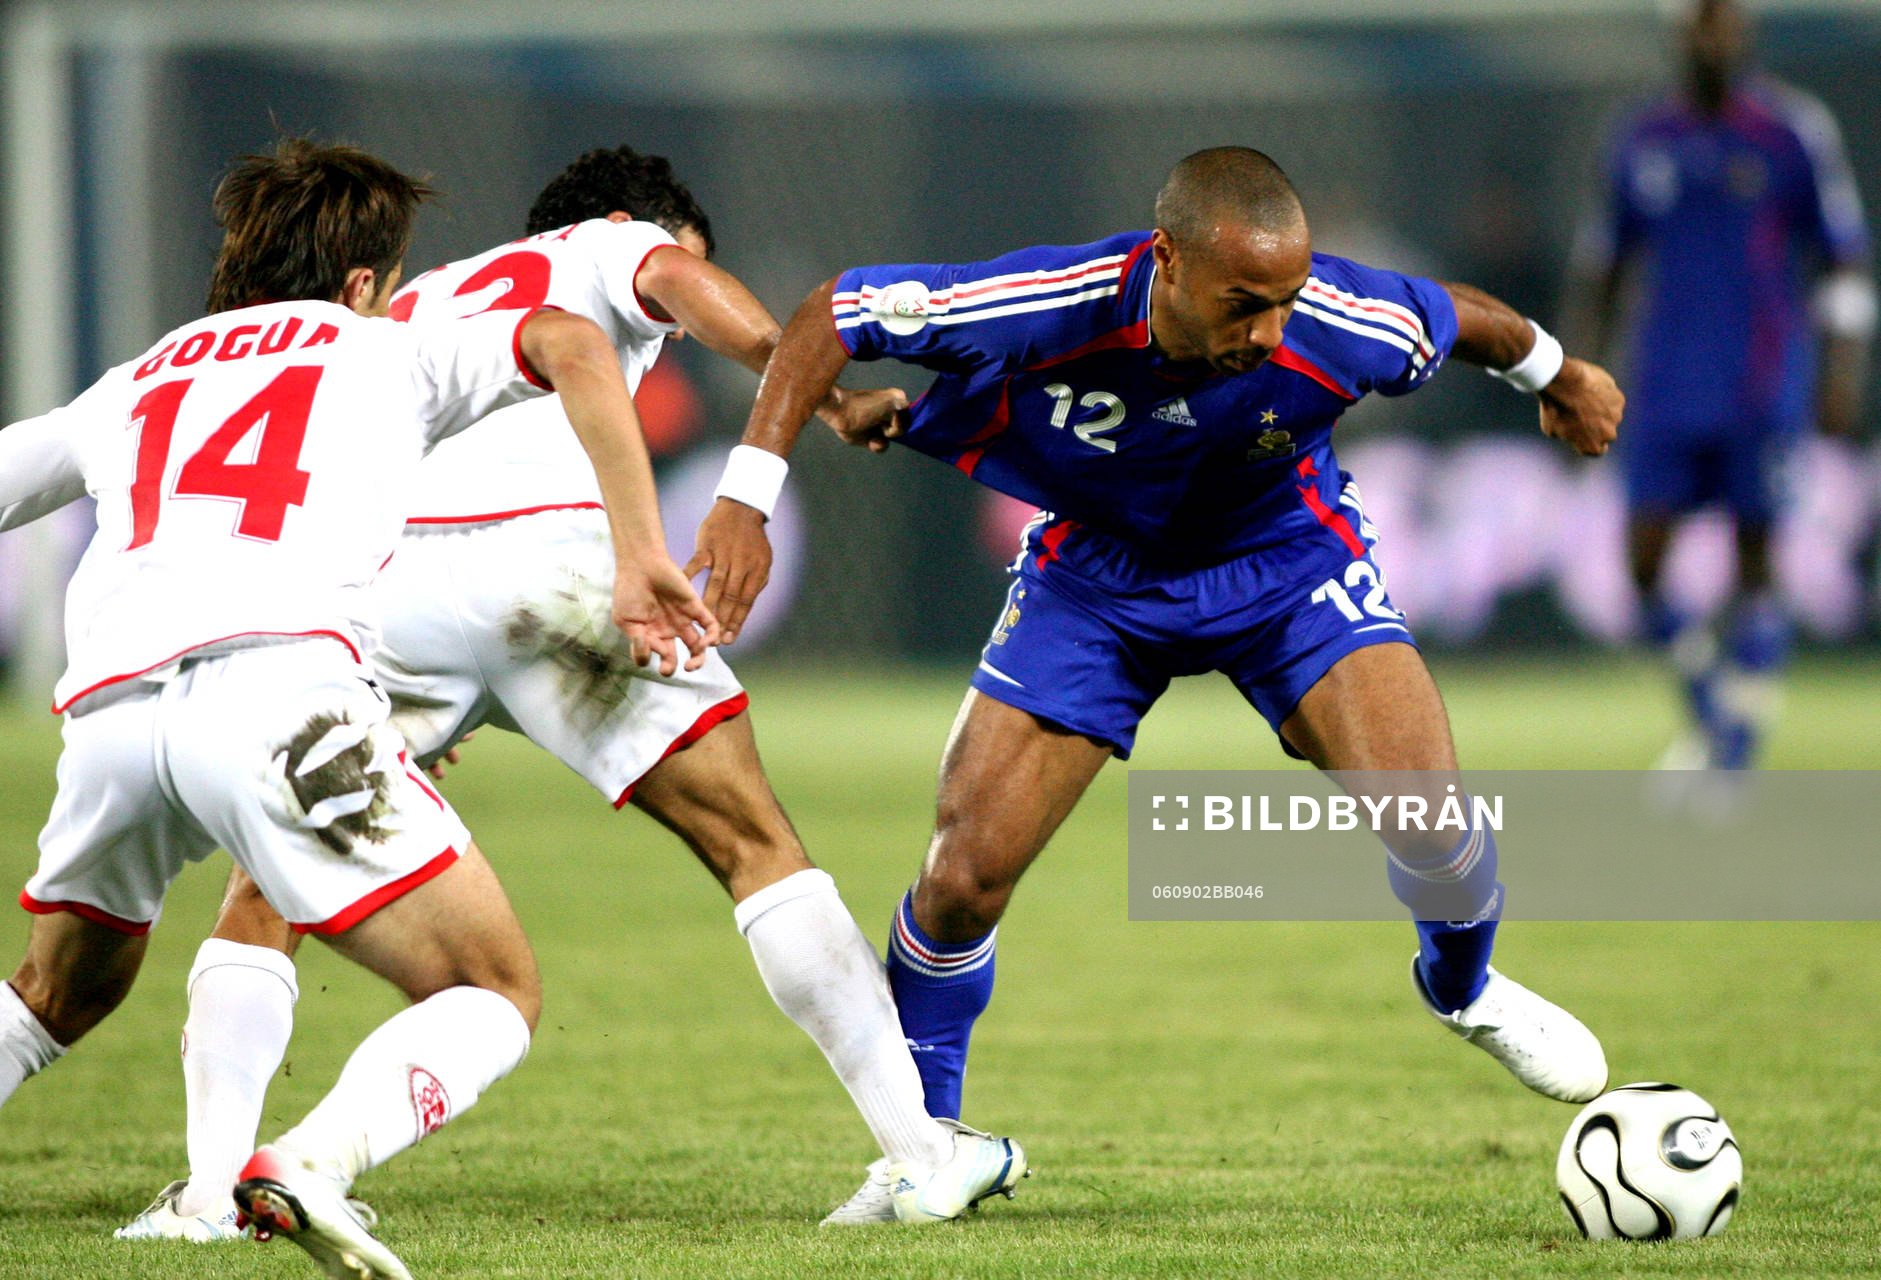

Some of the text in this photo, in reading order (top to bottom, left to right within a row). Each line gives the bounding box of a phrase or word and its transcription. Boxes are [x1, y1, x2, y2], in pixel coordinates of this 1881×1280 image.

[1043, 382, 1127, 453] 12
[1151, 410, 1198, 428] adidas
[118, 365, 325, 553] 14
[1311, 560, 1404, 622] 12
